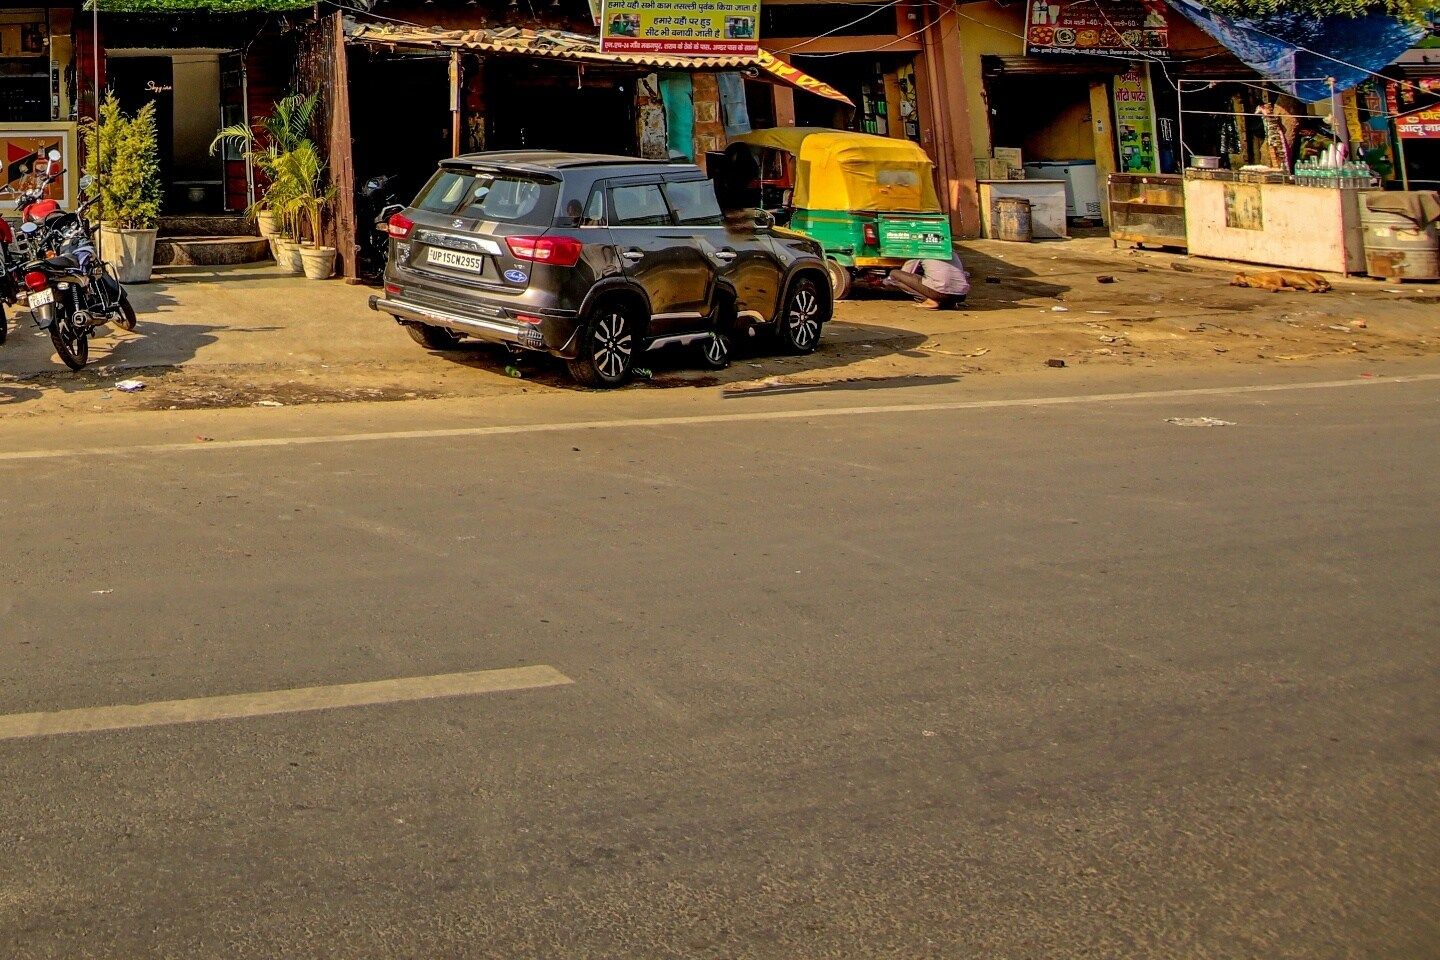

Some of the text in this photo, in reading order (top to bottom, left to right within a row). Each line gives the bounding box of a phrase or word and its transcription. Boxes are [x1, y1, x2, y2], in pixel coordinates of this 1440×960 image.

[608, 0, 625, 9] हमारे
[641, 0, 655, 9] सभी
[673, 1, 697, 10] तसल्ली
[716, 1, 733, 11] किया
[734, 3, 750, 11] जाता
[751, 3, 757, 12] है
[653, 15, 672, 25] हमारे
[689, 17, 699, 26] पर
[645, 27, 720, 38] सीट भी जाती है
[1398, 122, 1425, 136] आलू
